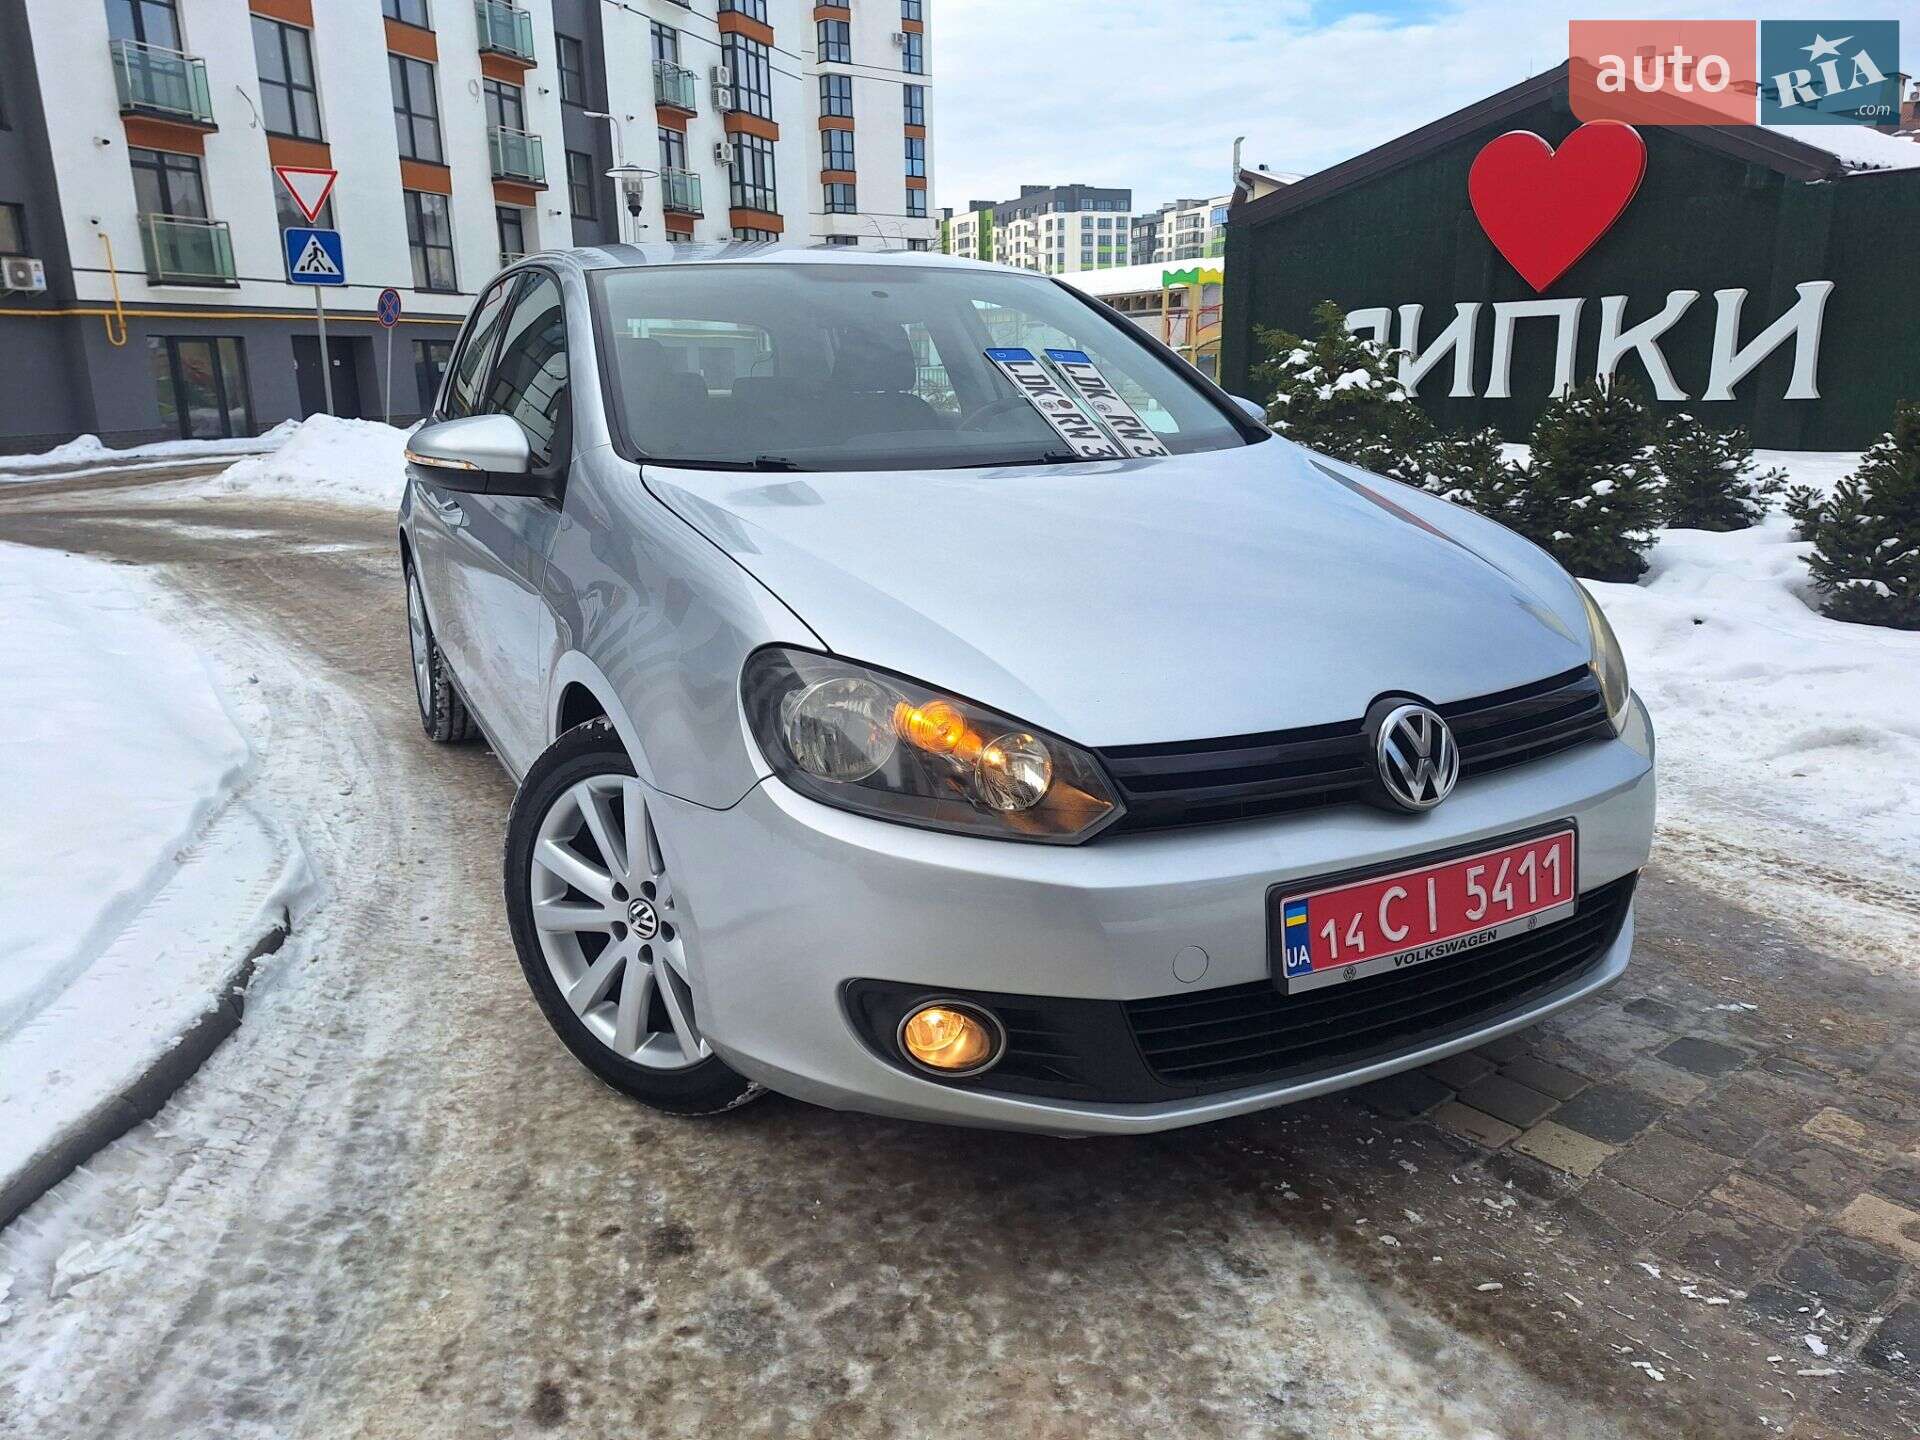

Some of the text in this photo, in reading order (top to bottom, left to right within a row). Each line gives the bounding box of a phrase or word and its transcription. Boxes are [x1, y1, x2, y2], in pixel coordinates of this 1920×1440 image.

[1003, 361, 1064, 403] LDK
[1051, 413, 1102, 441] RW
[1060, 363, 1118, 402] LDK
[1105, 414, 1154, 442] RW
[1465, 843, 1562, 922] 5411
[1286, 946, 1311, 969] UA
[1393, 929, 1498, 968] VOLKSWAGEN
